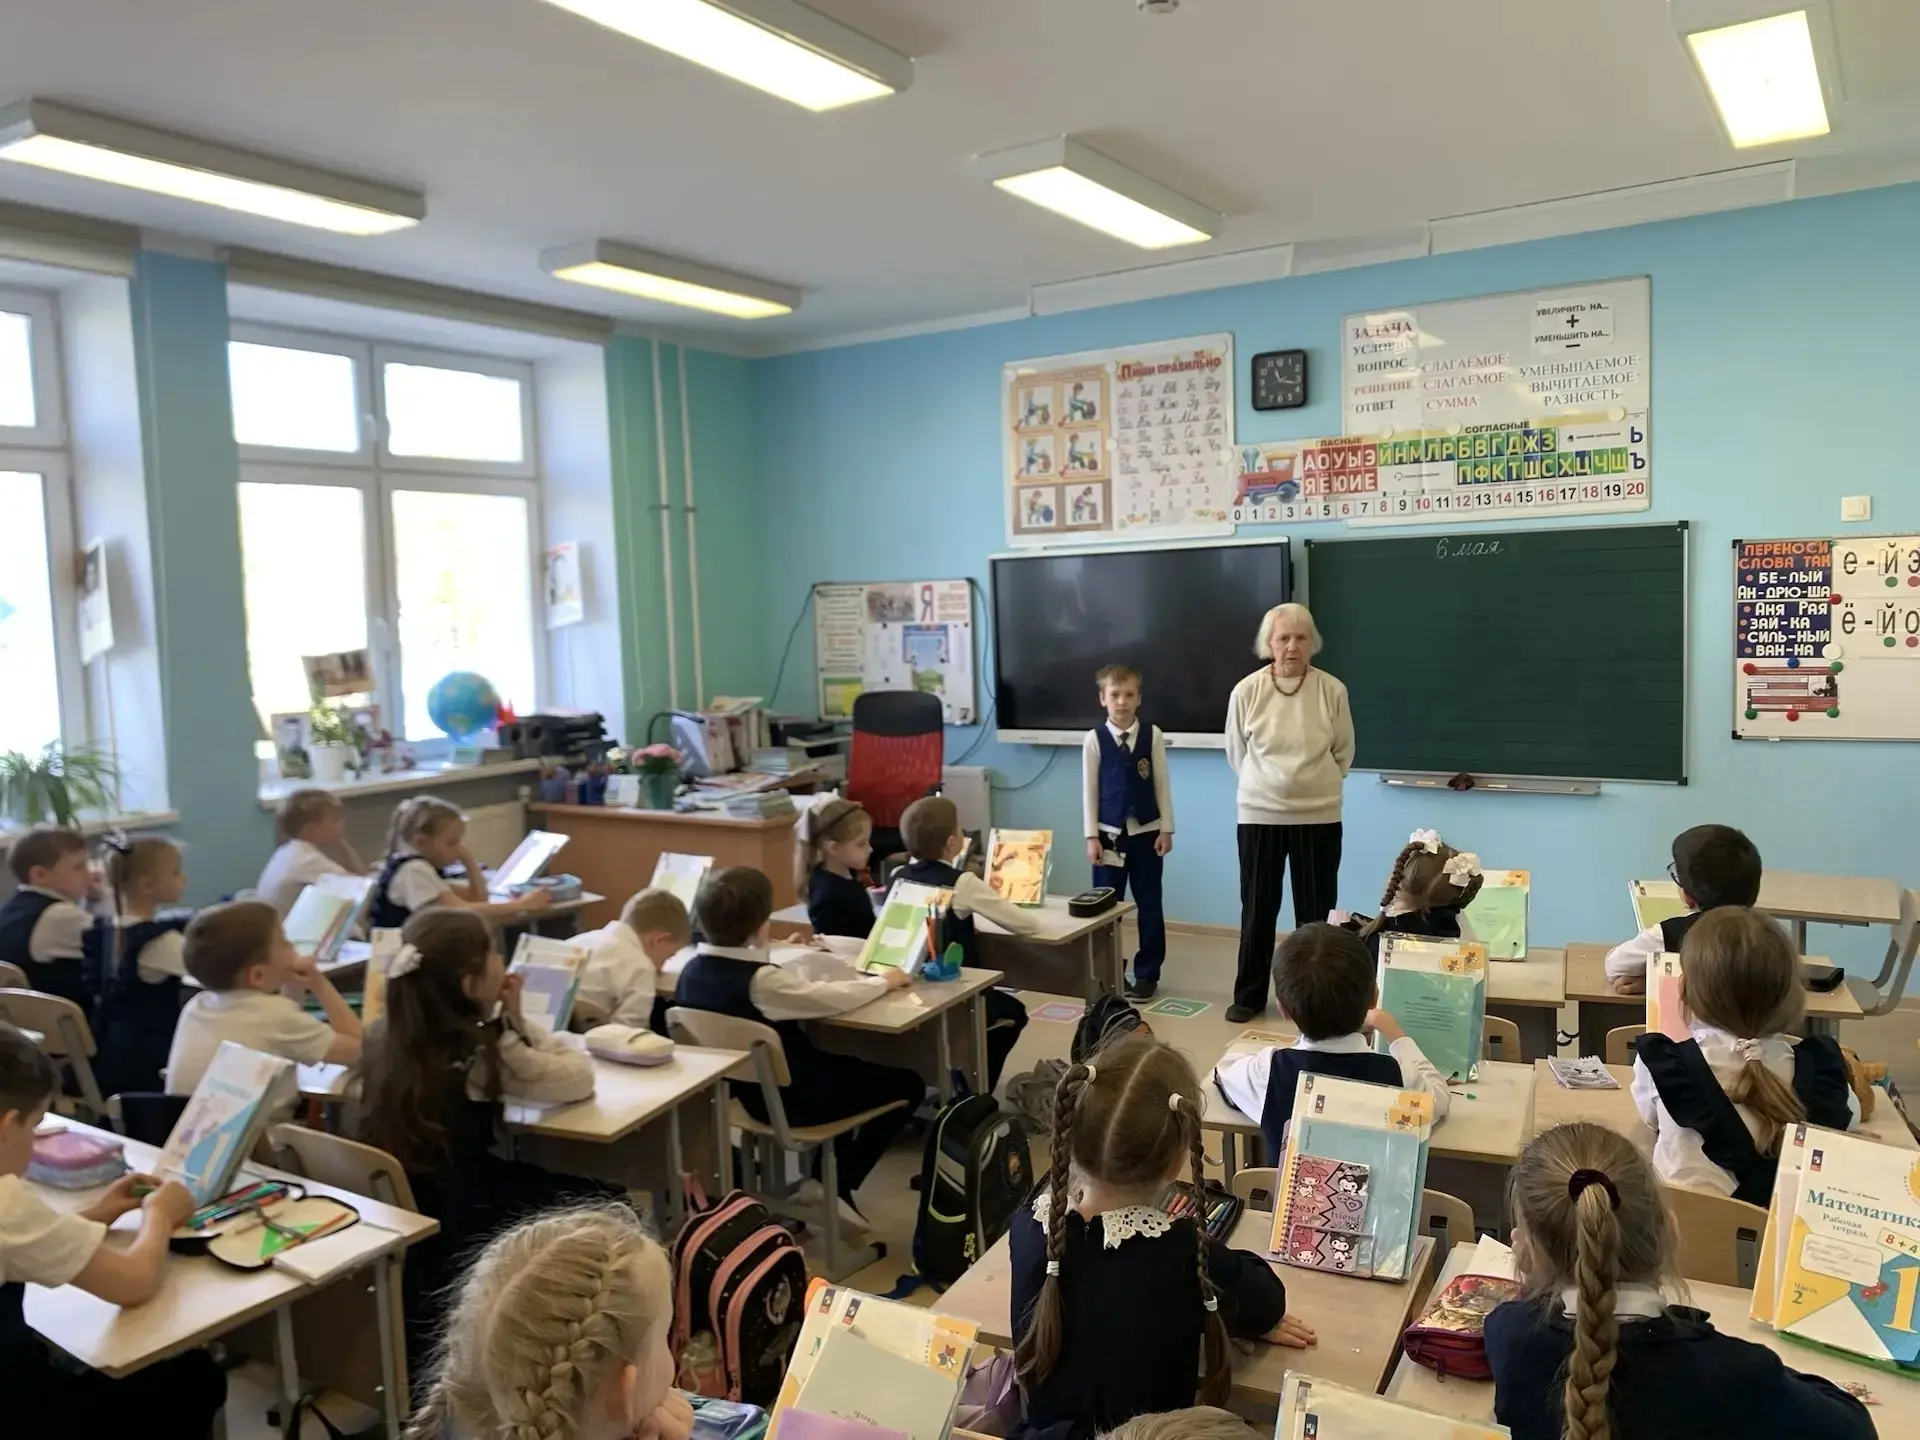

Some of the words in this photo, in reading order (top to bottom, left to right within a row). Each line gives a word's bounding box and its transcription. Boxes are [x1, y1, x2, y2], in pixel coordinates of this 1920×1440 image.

[1536, 304, 1586, 316] УВЕЛИЧИТЬ
[1534, 331, 1589, 343] УМЕНЬШИТЬ
[1356, 357, 1408, 374] ВОПРОС
[1355, 399, 1395, 414] ОТВЕТ
[1426, 396, 1478, 411] СУММА
[1465, 421, 1530, 434] СОГЛАСНЫЕ
[1234, 509, 1241, 521] 0
[1252, 509, 1258, 520] 1
[1269, 508, 1276, 519] 2
[1287, 507, 1294, 518] 3
[1305, 506, 1312, 517] 4
[1323, 505, 1331, 516] 5
[1342, 503, 1350, 515] 6
[1361, 502, 1369, 514] 7
[1380, 501, 1388, 513] 8
[1399, 500, 1407, 511] 9
[1415, 498, 1430, 510] 10
[1436, 497, 1450, 509] 11
[1455, 495, 1471, 508] 12
[1475, 494, 1491, 506] 13
[1496, 492, 1512, 505] 14
[1517, 490, 1533, 503] 15
[1538, 489, 1555, 502] 16
[1560, 487, 1576, 500] 17
[1582, 485, 1599, 499] 18
[1604, 484, 1621, 497] 19
[1626, 482, 1645, 496] 20
[1436, 537, 1449, 559] 6
[1452, 540, 1503, 556] мая
[1744, 541, 1829, 556] ПЕРЕНОСИ
[1738, 556, 1794, 569] СЛОВА
[1803, 555, 1832, 568] ТАК
[1758, 568, 1823, 584] БЕ-ЛЫЙ
[1749, 615, 1811, 630] ЗАЙ-КА
[1747, 628, 1830, 643] СИЛЬ-НЫЙ
[1755, 644, 1814, 657] ВАН-НА
[1822, 1213, 1862, 1229] Рабочая
[1832, 1224, 1868, 1239] тетрадь
[1885, 1234, 1895, 1245] 8
[1909, 1244, 1918, 1254] 4
[1791, 1290, 1803, 1305] 2
[1882, 1265, 1919, 1334] 1
